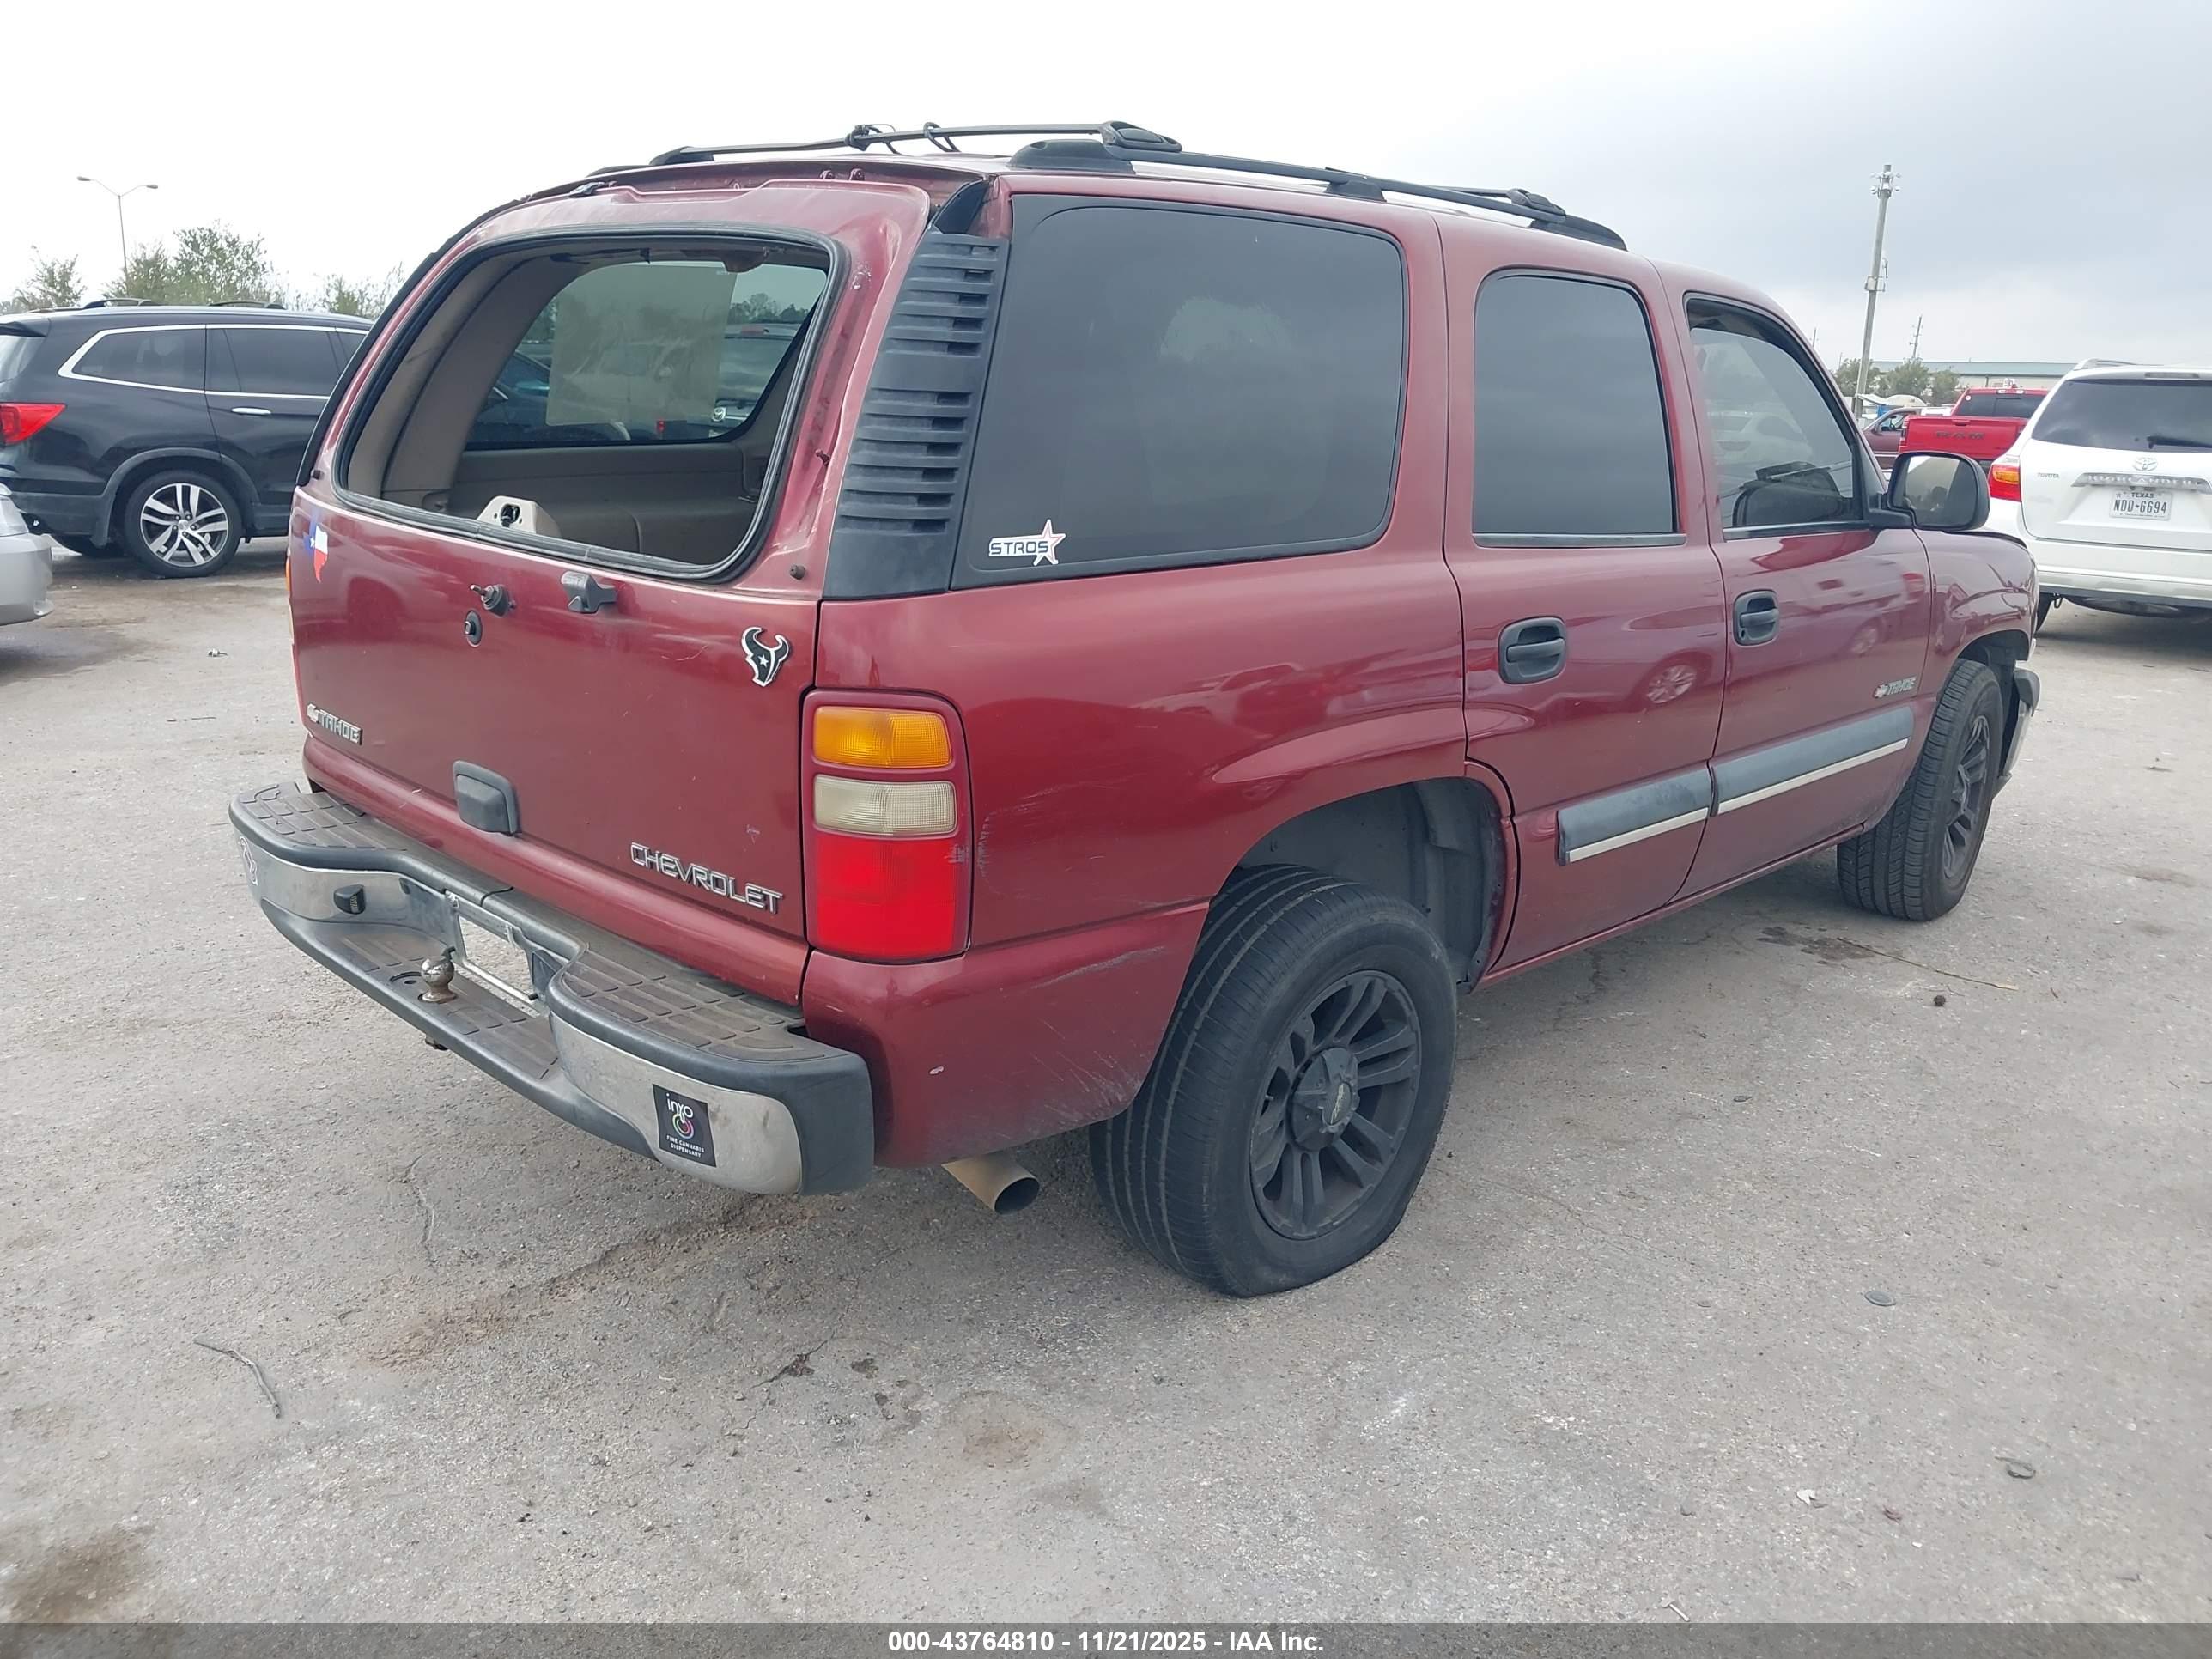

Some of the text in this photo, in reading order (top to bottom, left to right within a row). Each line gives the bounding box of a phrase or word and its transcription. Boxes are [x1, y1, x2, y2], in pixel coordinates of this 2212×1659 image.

[990, 540, 1048, 555] STROS
[319, 709, 362, 744] TAHOE
[631, 842, 783, 914] CHEVROLET
[671, 1142, 702, 1158] DISPENSARY
